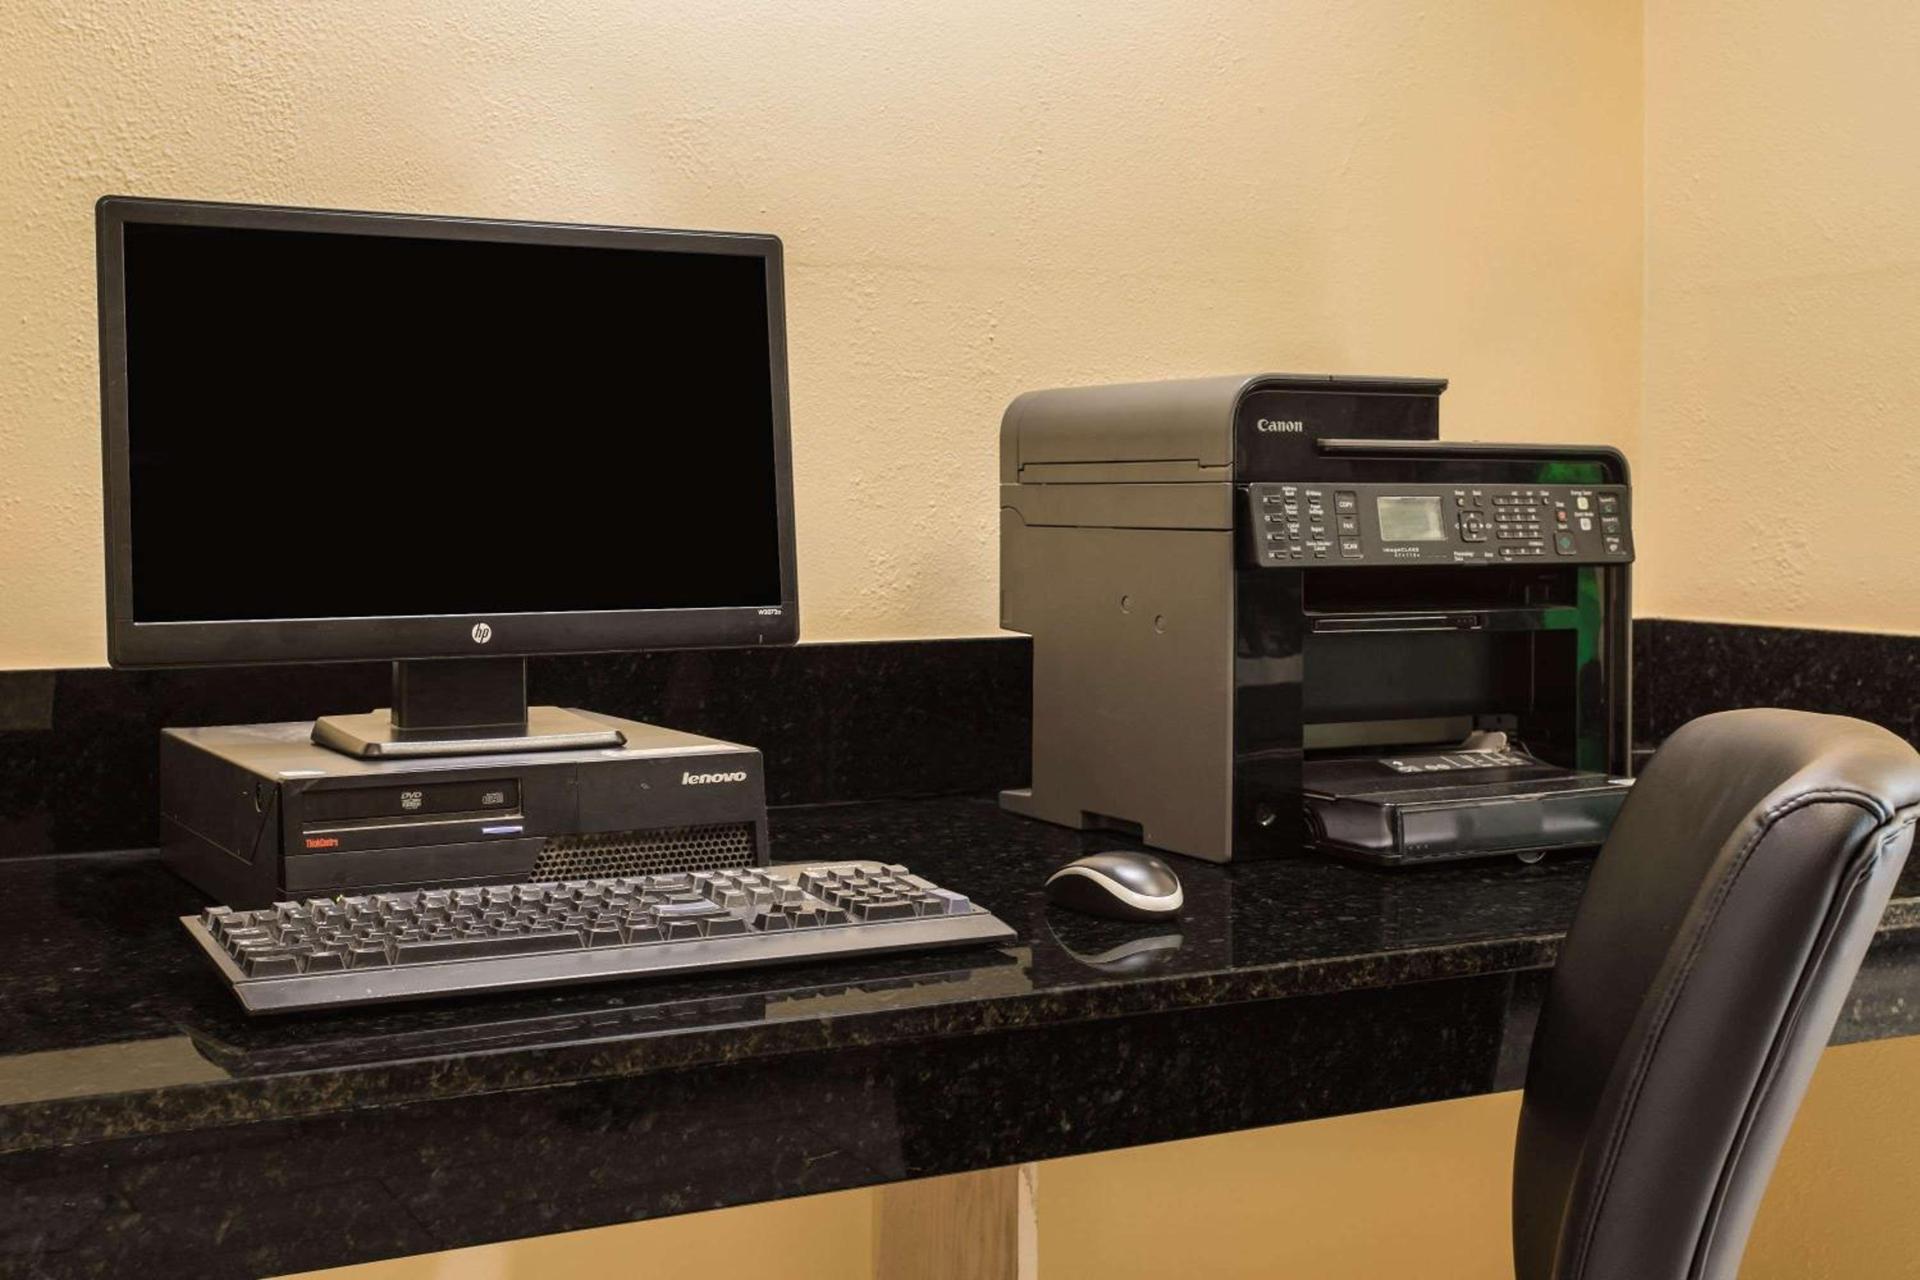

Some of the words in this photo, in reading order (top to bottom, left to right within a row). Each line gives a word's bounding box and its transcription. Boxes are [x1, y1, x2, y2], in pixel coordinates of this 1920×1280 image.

[1257, 418, 1303, 432] Canon
[473, 622, 491, 644] hp
[681, 771, 747, 785] lenovo
[401, 791, 423, 800] DVD
